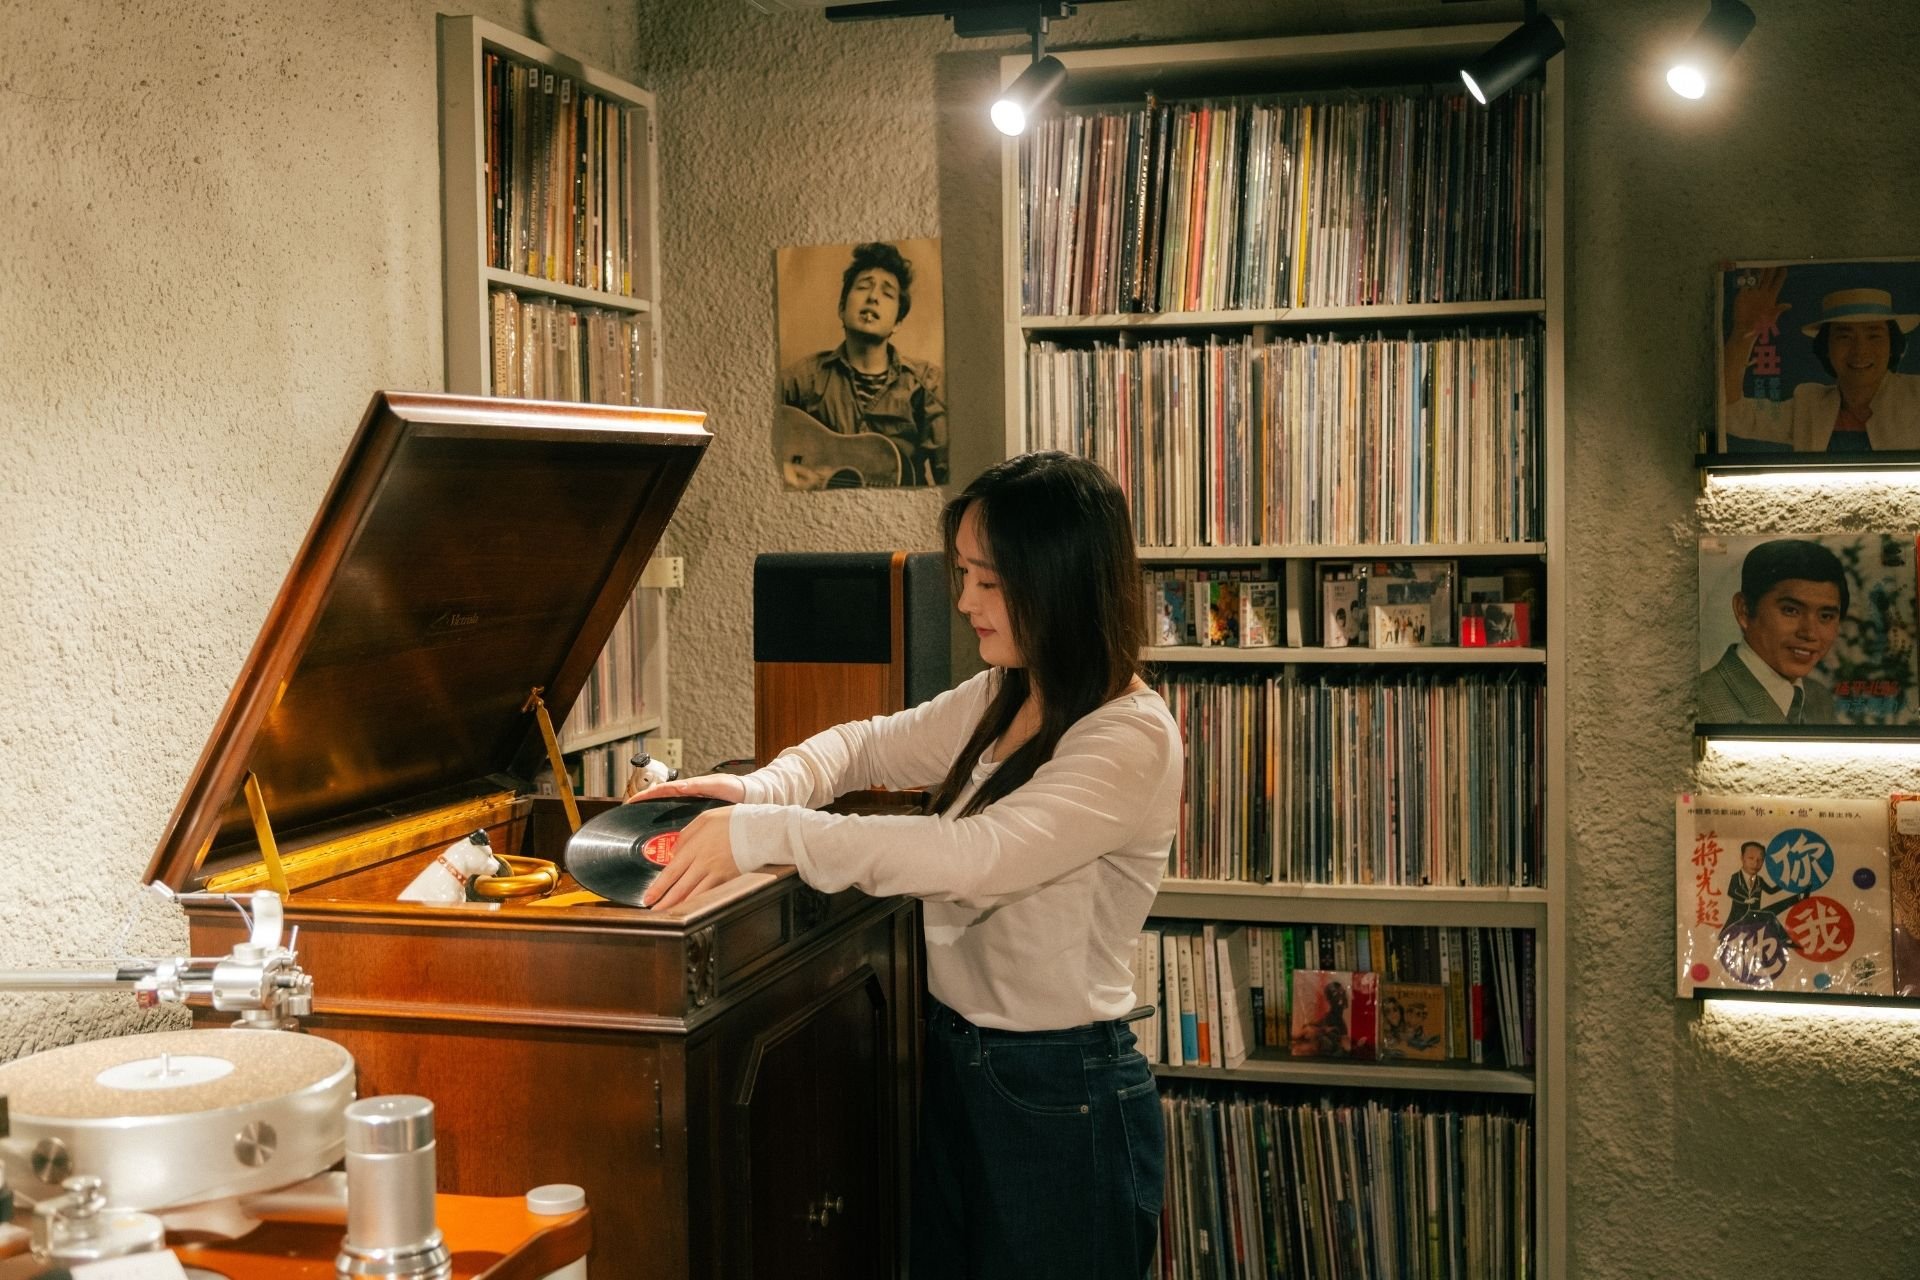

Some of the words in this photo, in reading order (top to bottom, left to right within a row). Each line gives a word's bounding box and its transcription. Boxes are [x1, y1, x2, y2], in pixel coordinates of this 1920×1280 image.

[1691, 830, 1724, 929] 蔣光超
[1771, 833, 1828, 888] 你
[1728, 927, 1784, 980] 他
[1793, 902, 1847, 955] 我
